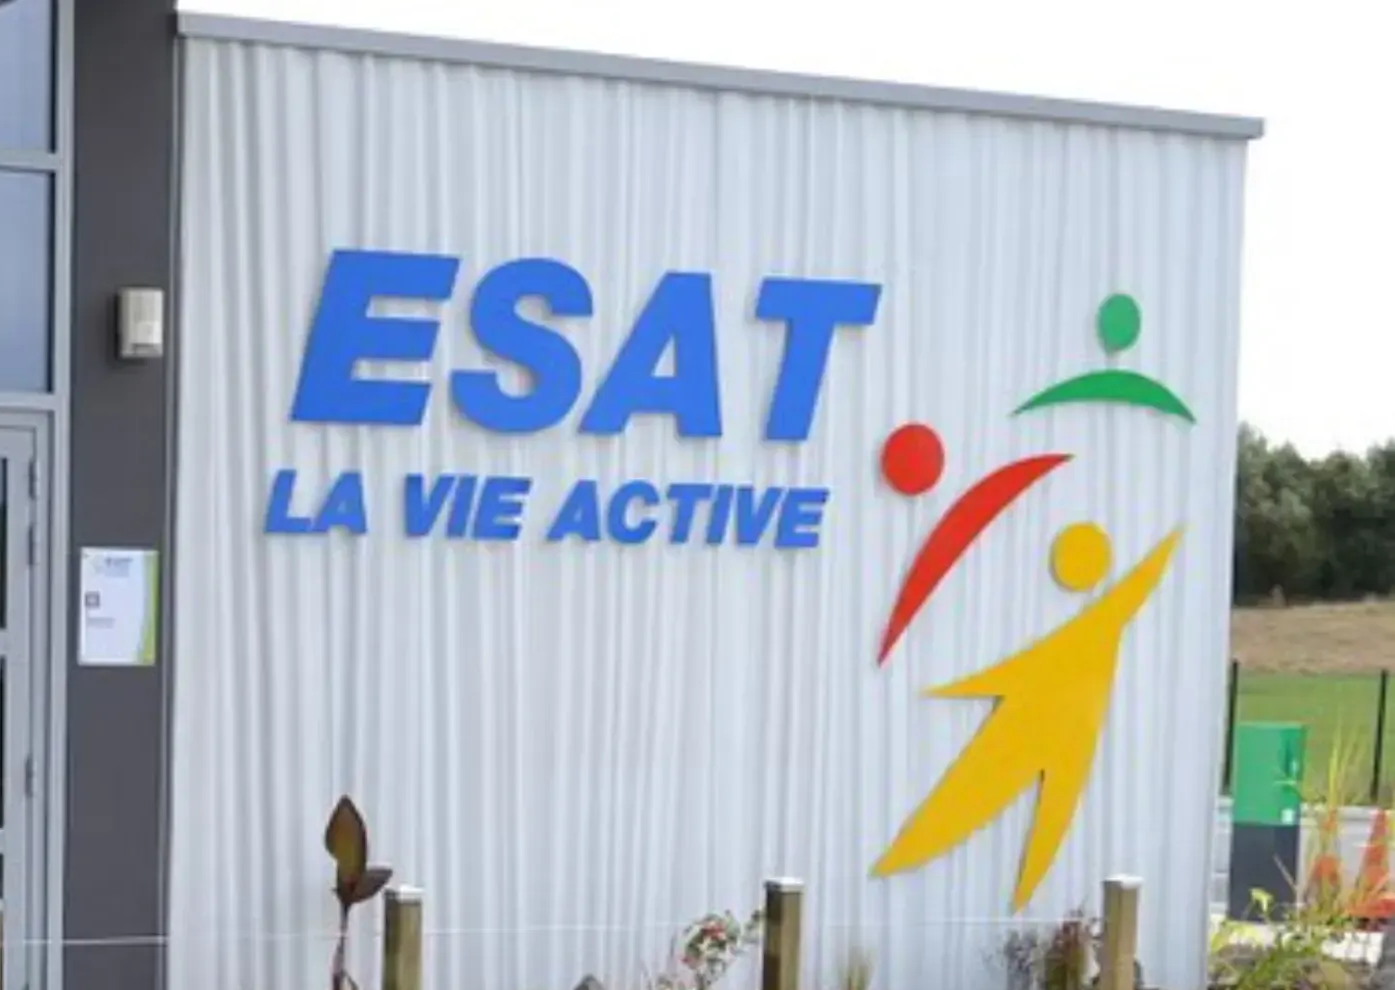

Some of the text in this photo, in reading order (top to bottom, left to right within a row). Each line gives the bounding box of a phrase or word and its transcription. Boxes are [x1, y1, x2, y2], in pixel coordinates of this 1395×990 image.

[290, 249, 881, 442] ESAT
[264, 470, 830, 549] LA VIE ACTIVE
